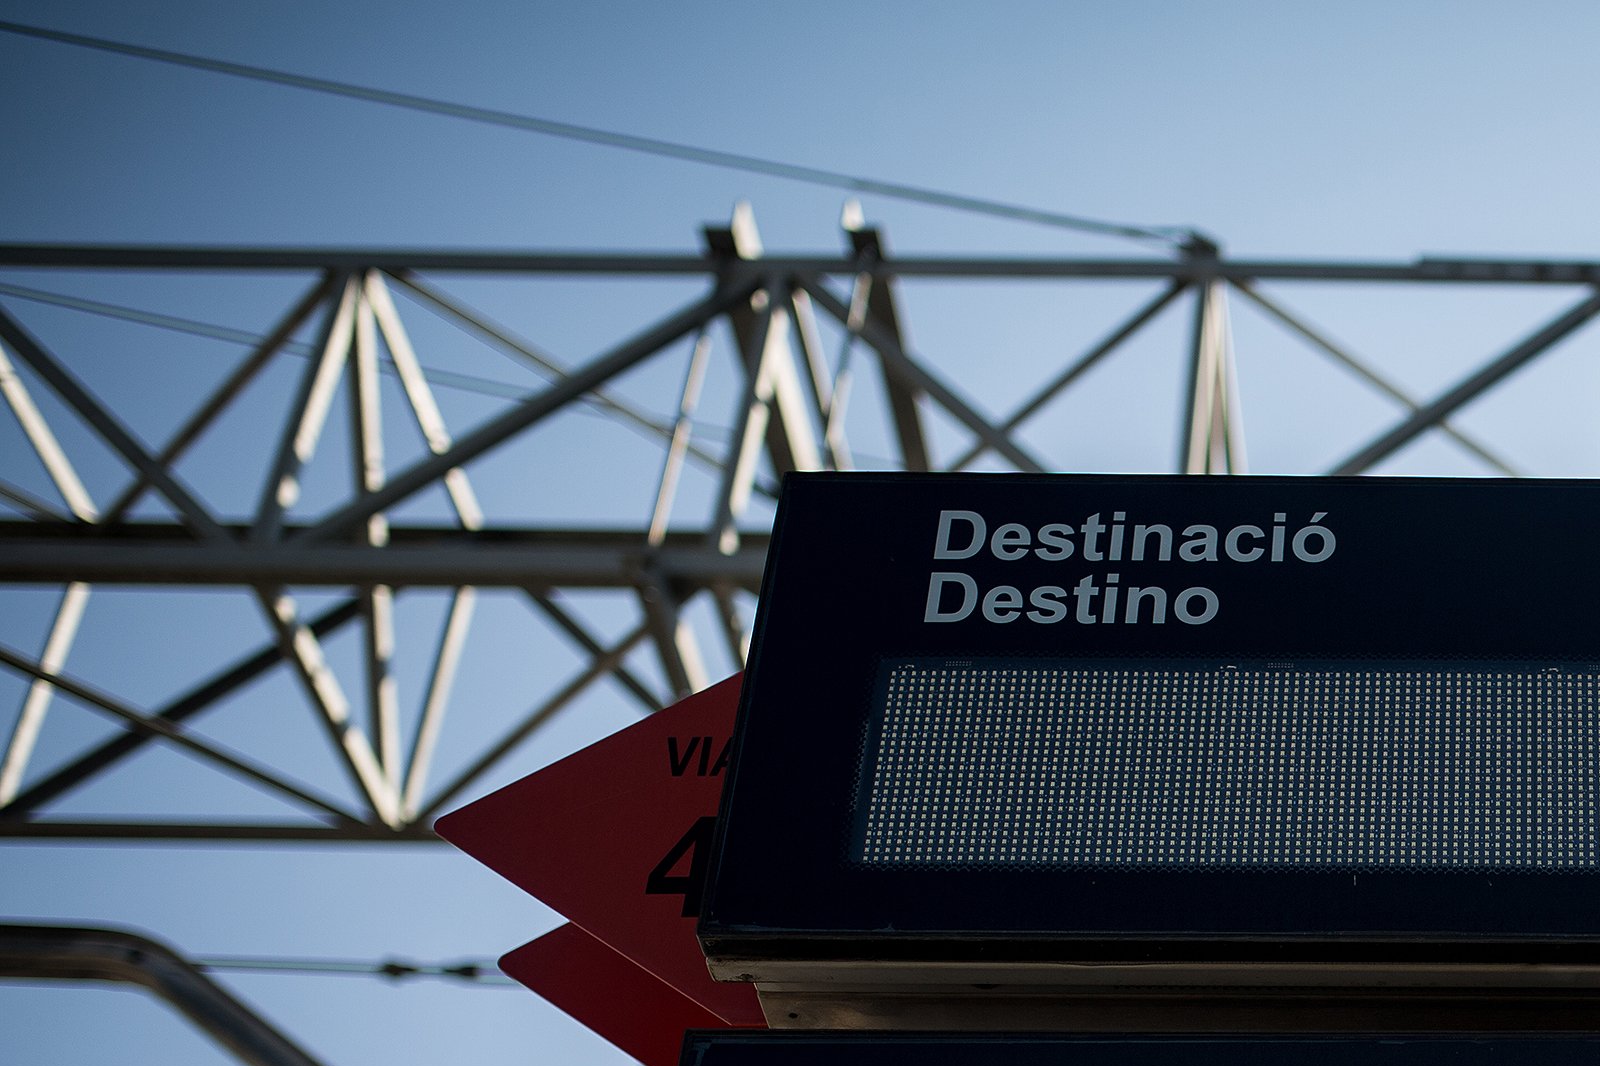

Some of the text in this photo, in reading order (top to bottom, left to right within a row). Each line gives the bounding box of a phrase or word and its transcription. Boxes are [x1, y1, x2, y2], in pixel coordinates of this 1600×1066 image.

[932, 510, 1338, 565] Destinació
[923, 571, 1221, 626] Destino
[645, 816, 719, 918] 4
